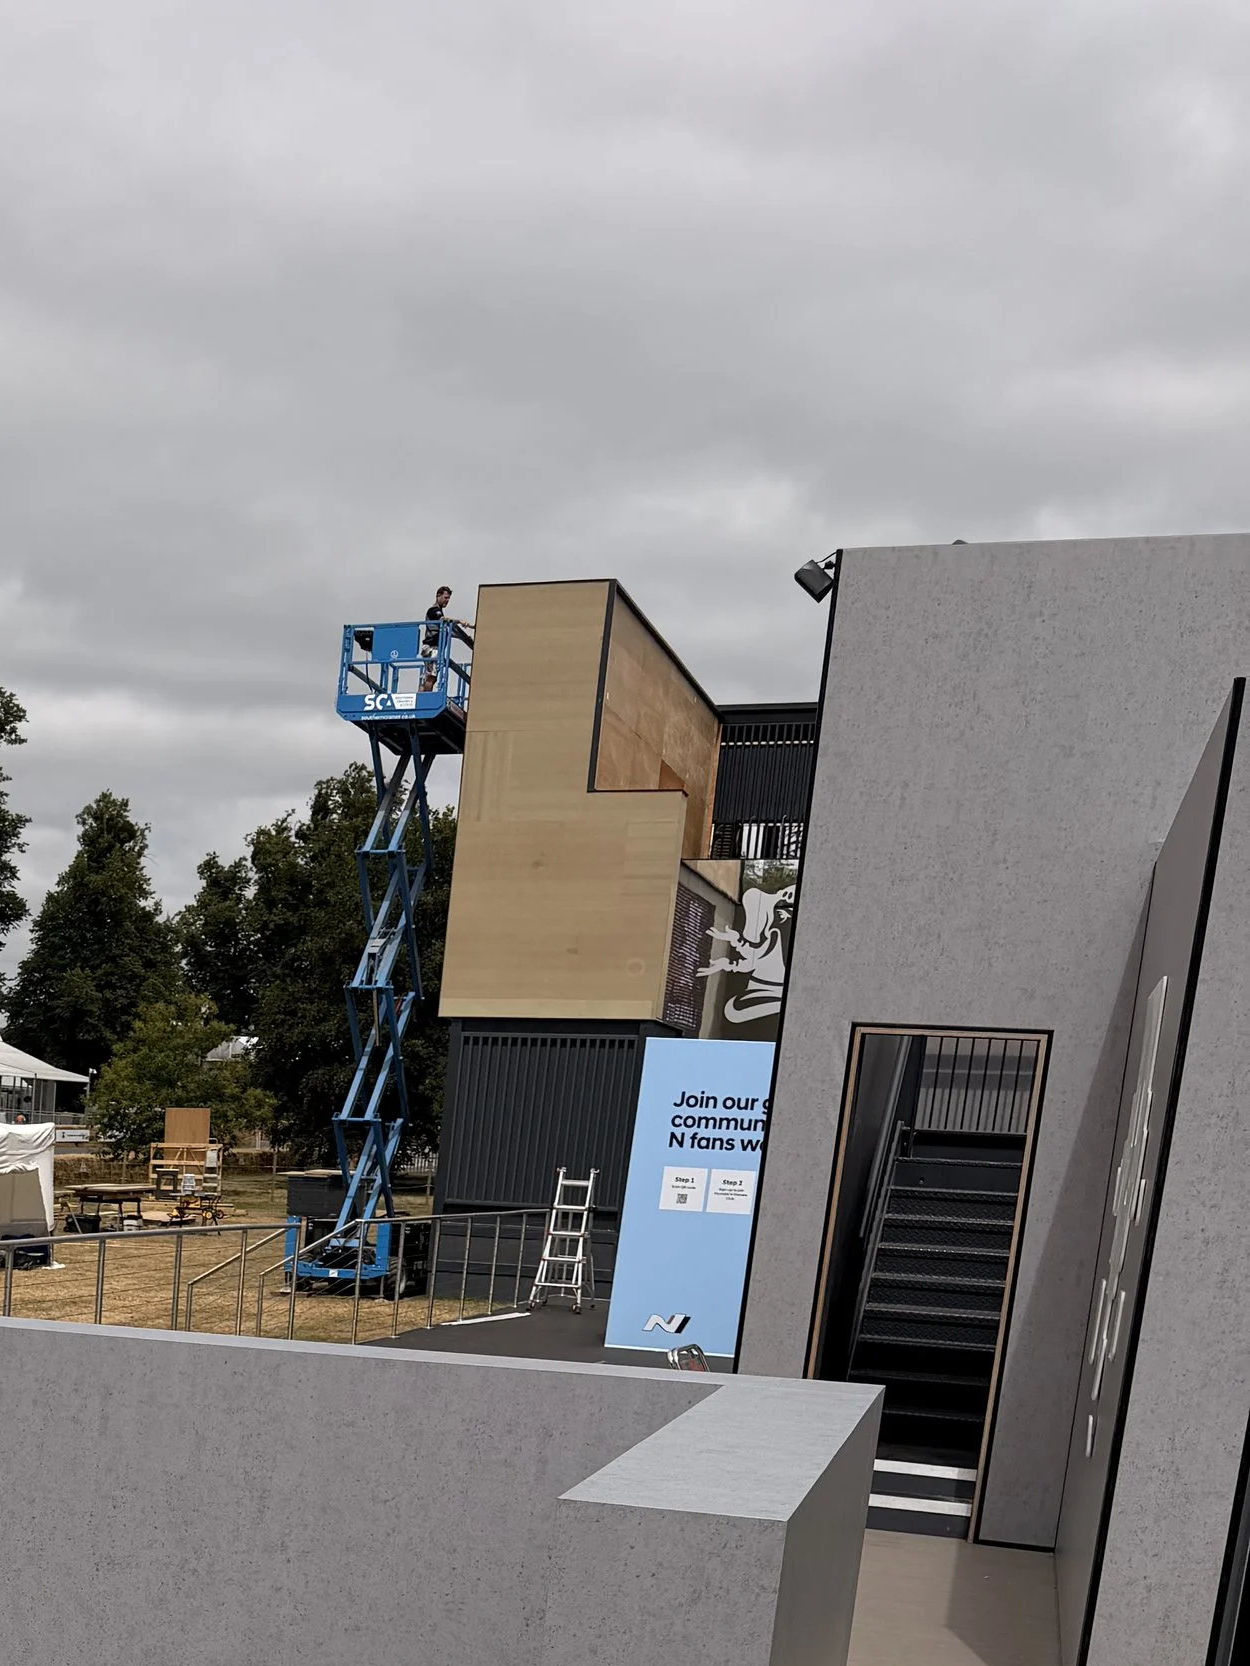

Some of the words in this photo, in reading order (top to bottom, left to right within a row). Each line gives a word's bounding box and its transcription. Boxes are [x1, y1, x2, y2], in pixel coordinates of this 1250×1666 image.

[673, 1091, 718, 1109] Join
[722, 1097, 759, 1111] our
[668, 1132, 685, 1148] N
[690, 1132, 735, 1151] fans
